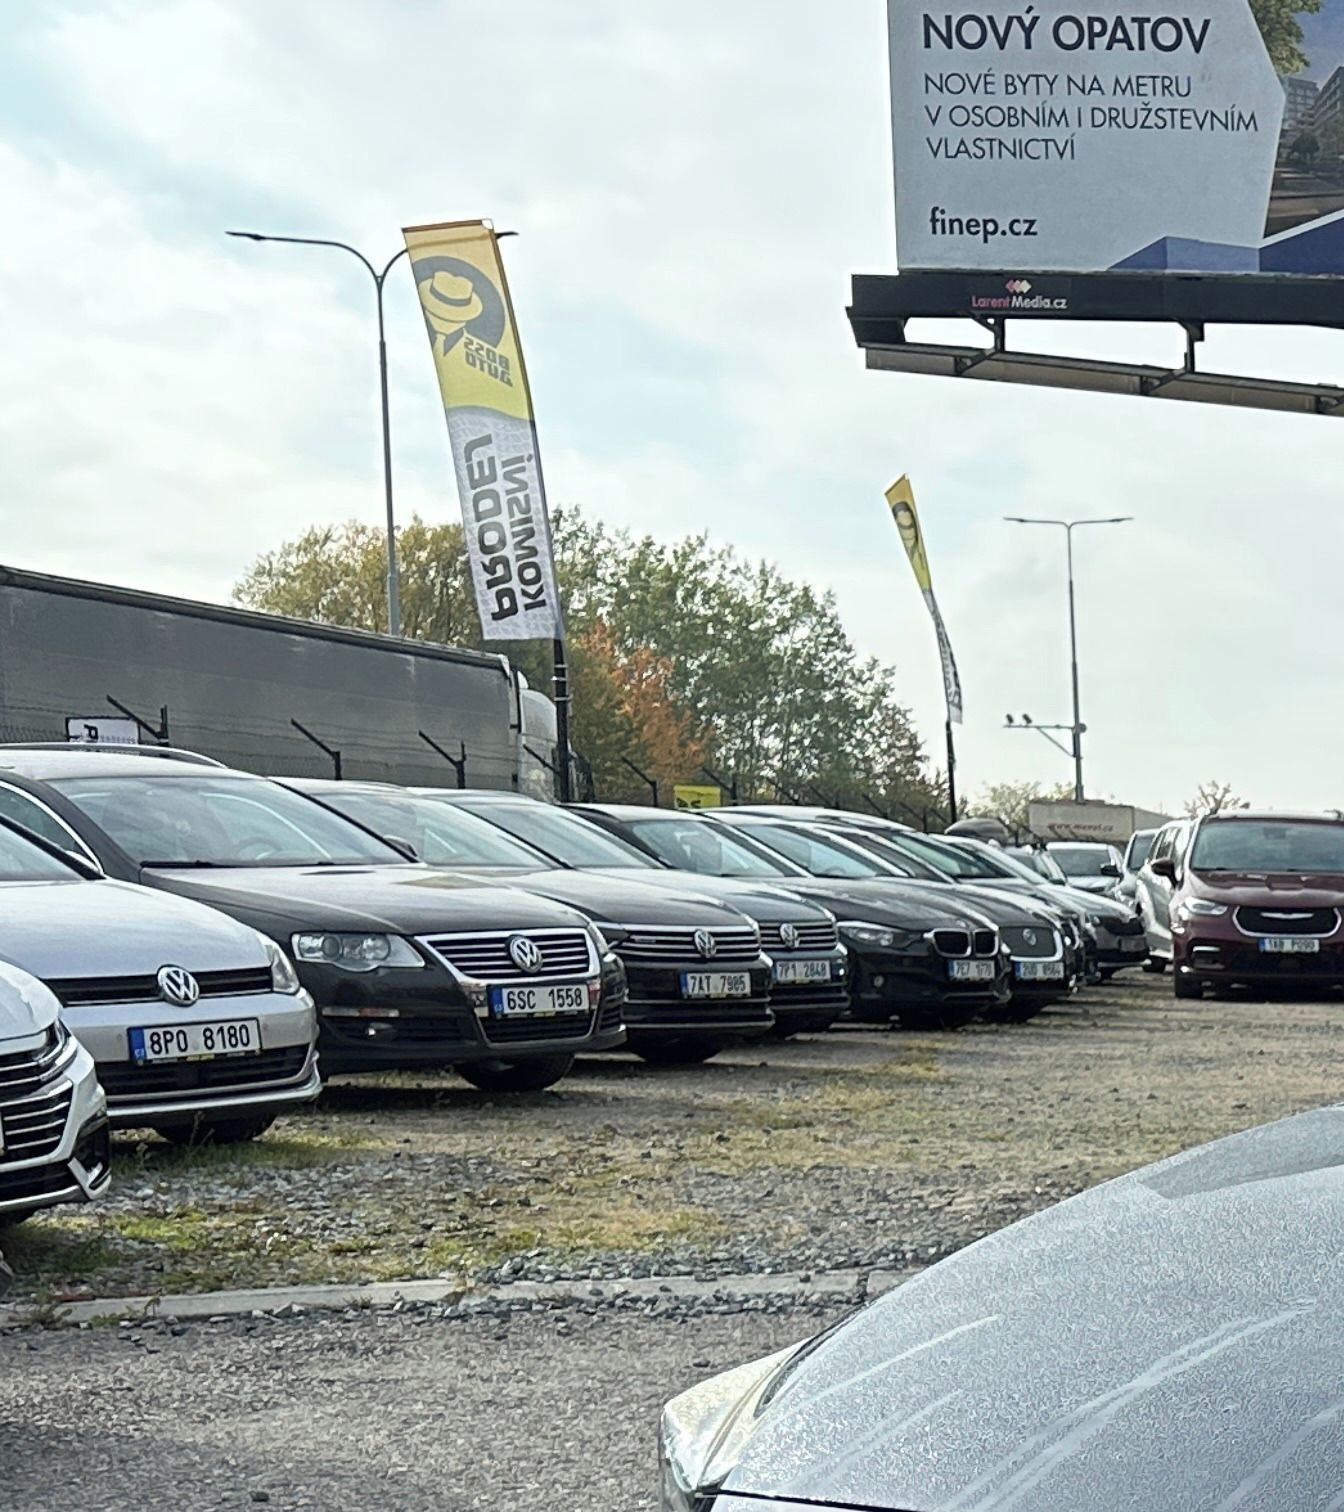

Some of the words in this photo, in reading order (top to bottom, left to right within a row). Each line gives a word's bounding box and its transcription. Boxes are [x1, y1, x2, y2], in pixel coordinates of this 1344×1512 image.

[922, 5, 1041, 50] NOVÝ
[1052, 15, 1211, 54] OPATOV
[924, 68, 996, 95] NOVÉ
[1004, 74, 1058, 96] BYTY
[1067, 75, 1105, 97] NA
[1112, 75, 1192, 97] METRU
[924, 105, 942, 127] V
[949, 101, 1070, 128] OSOBNÍM
[1091, 102, 1258, 132] DRUŽSTEVNÍM
[926, 133, 1075, 160] VLASTNICTVÍ
[930, 206, 1038, 244] finep.cz
[507, 989, 537, 1010] 6SC
[549, 987, 583, 1008] 1558
[203, 1024, 250, 1050] 8180
